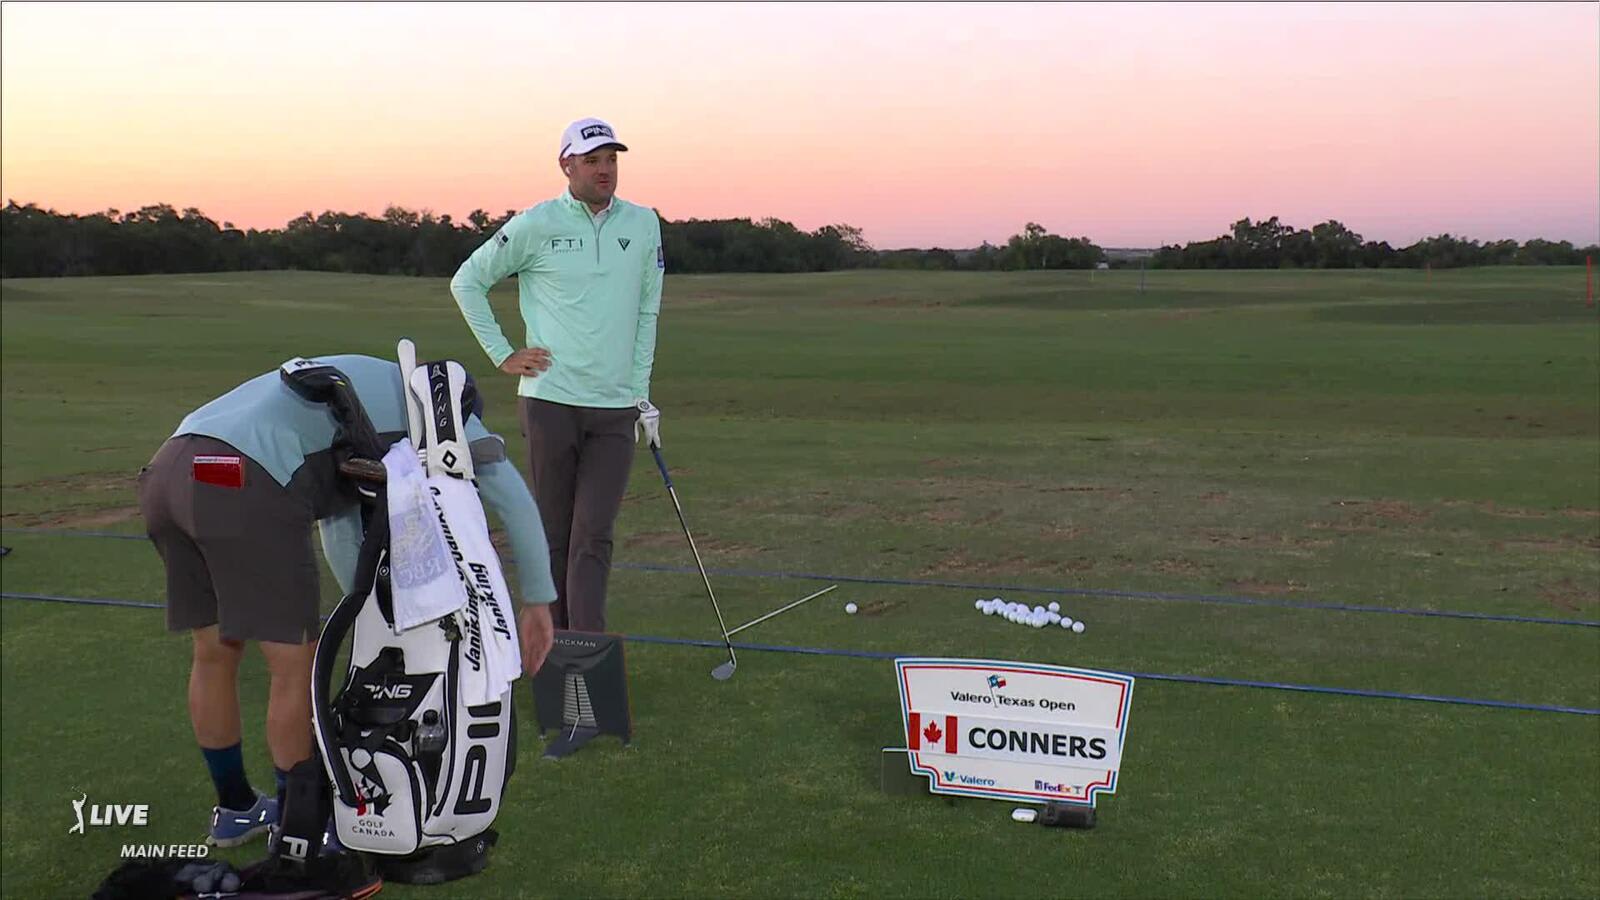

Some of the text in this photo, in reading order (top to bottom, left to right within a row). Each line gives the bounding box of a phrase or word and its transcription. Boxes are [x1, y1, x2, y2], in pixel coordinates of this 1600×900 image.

[583, 126, 612, 138] PING
[552, 237, 583, 249] FTI
[433, 383, 448, 428] PING
[469, 562, 511, 641] Janiking
[464, 585, 481, 672] Janiking
[363, 684, 413, 699] PING
[950, 691, 1076, 711] Valero Texas Open
[968, 727, 1107, 759] CONNERS
[959, 775, 995, 786] Valero
[1044, 782, 1072, 793] FedEx
[359, 819, 384, 829] GOLF
[352, 825, 396, 837] CANADA
